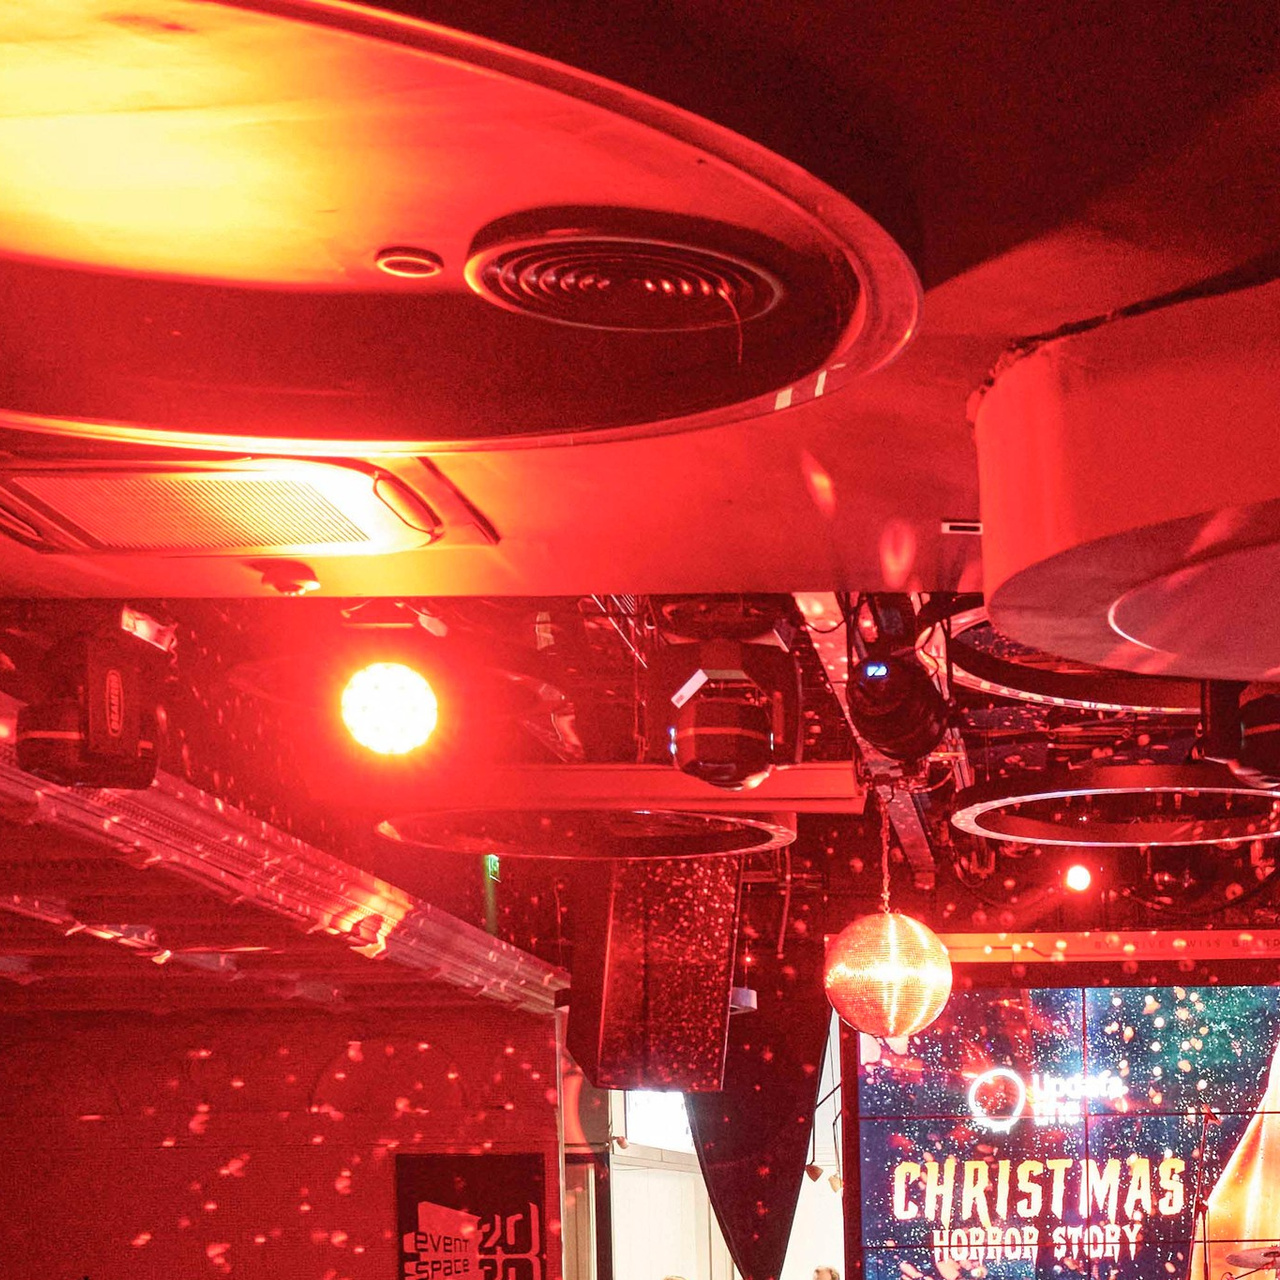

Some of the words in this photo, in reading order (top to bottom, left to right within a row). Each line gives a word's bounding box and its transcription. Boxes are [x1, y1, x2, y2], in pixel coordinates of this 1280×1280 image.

[1173, 939, 1221, 949] WISS
[892, 1157, 1186, 1230] CHRISTMAS
[414, 1221, 470, 1252] event
[478, 1206, 533, 1254] 20
[932, 1226, 1040, 1266] HORROR
[1052, 1223, 1143, 1264] STORY
